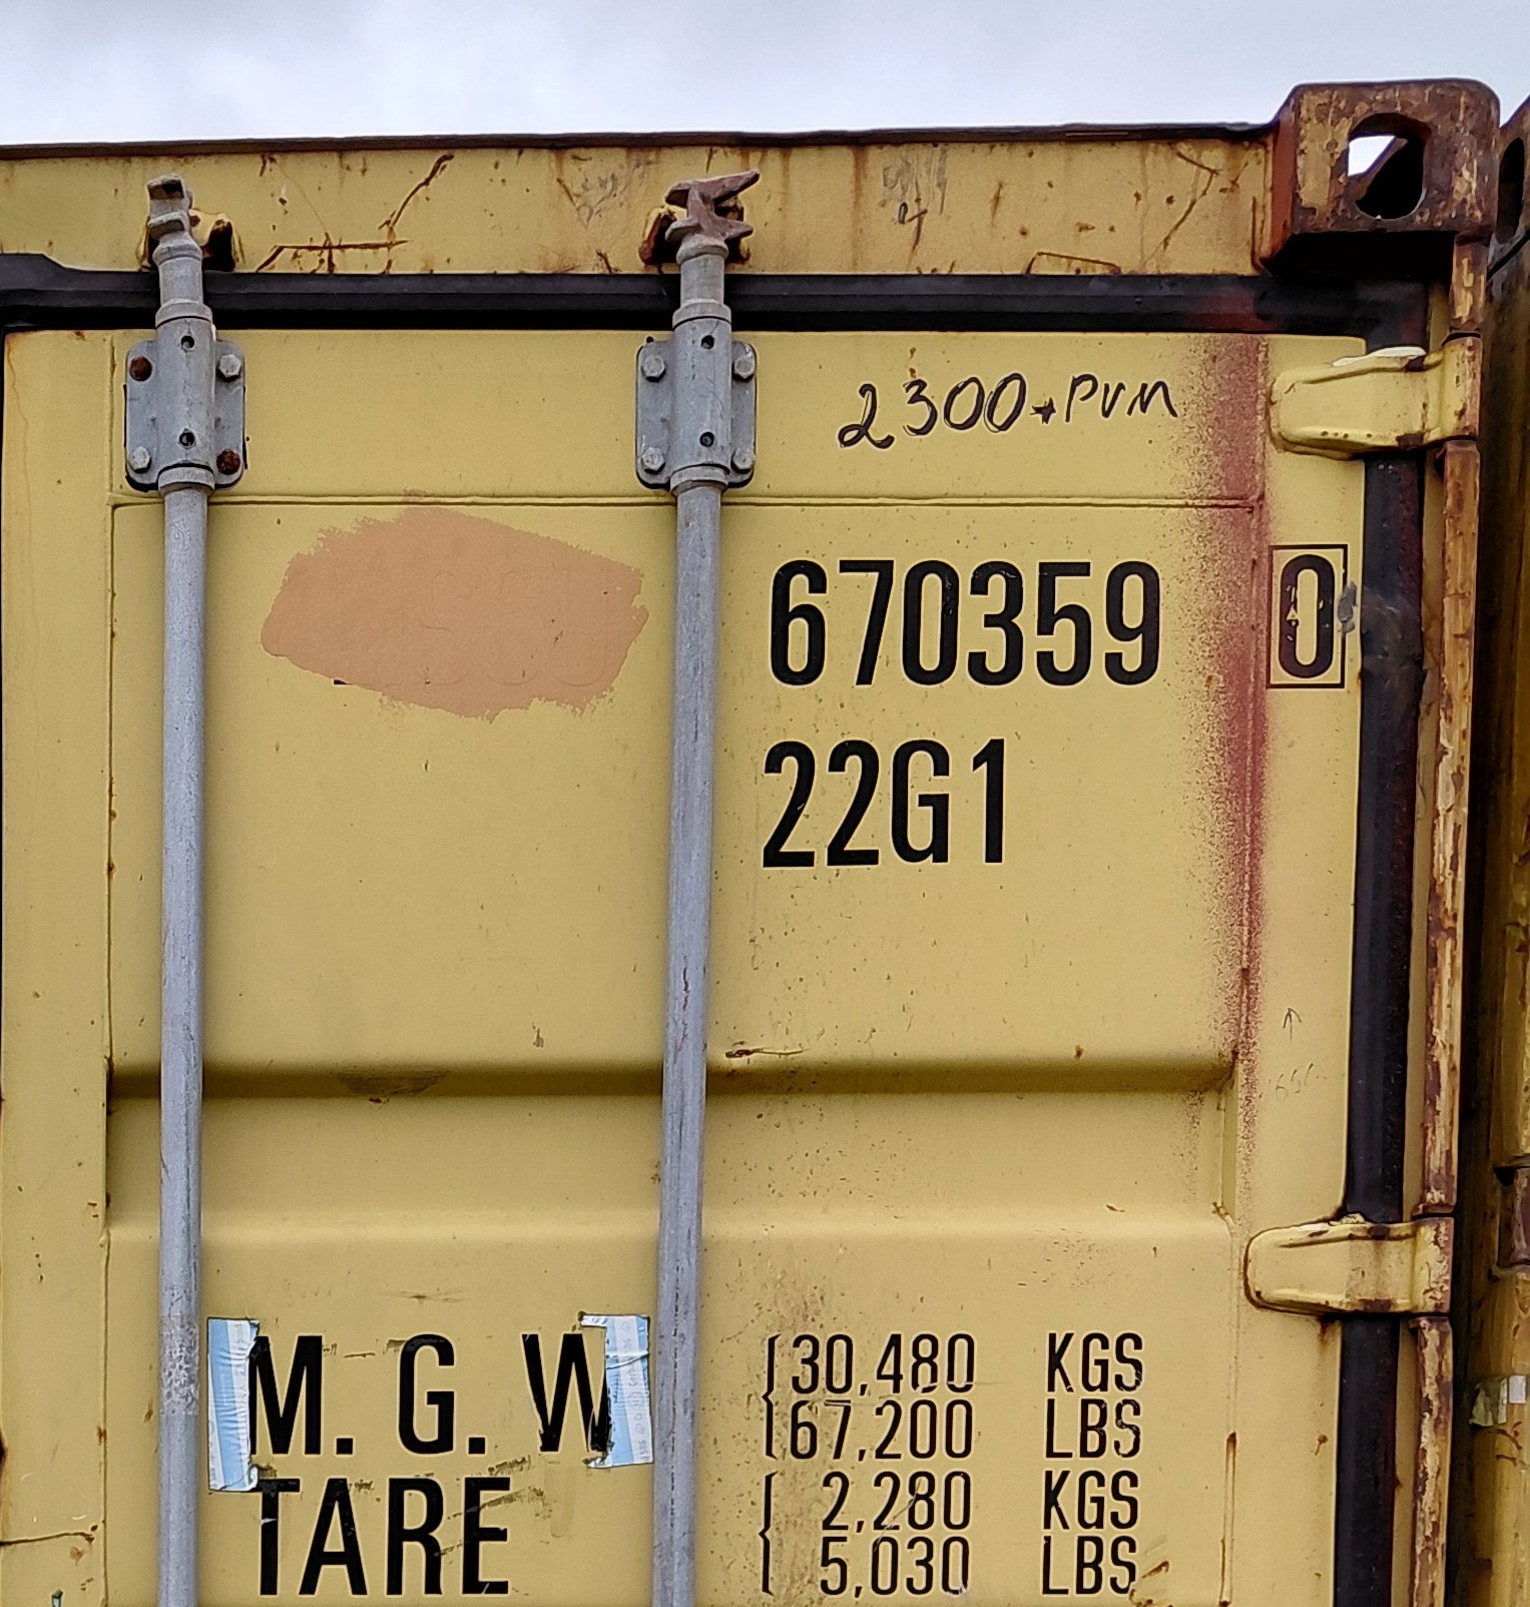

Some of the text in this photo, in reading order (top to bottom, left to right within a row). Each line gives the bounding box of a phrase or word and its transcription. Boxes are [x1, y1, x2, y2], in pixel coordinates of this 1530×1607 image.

[771, 555, 1334, 685] 670359 0
[763, 739, 1004, 867] 22G1
[399, 1335, 485, 1454] G.
[792, 1333, 1142, 1395] 30,480 KGS
[791, 1399, 1140, 1461] 67,200 LBS
[253, 1476, 510, 1595] TARE
[823, 1471, 1137, 1532] 2,280 KGS
[821, 1536, 1136, 1597] 5,030 LBS
